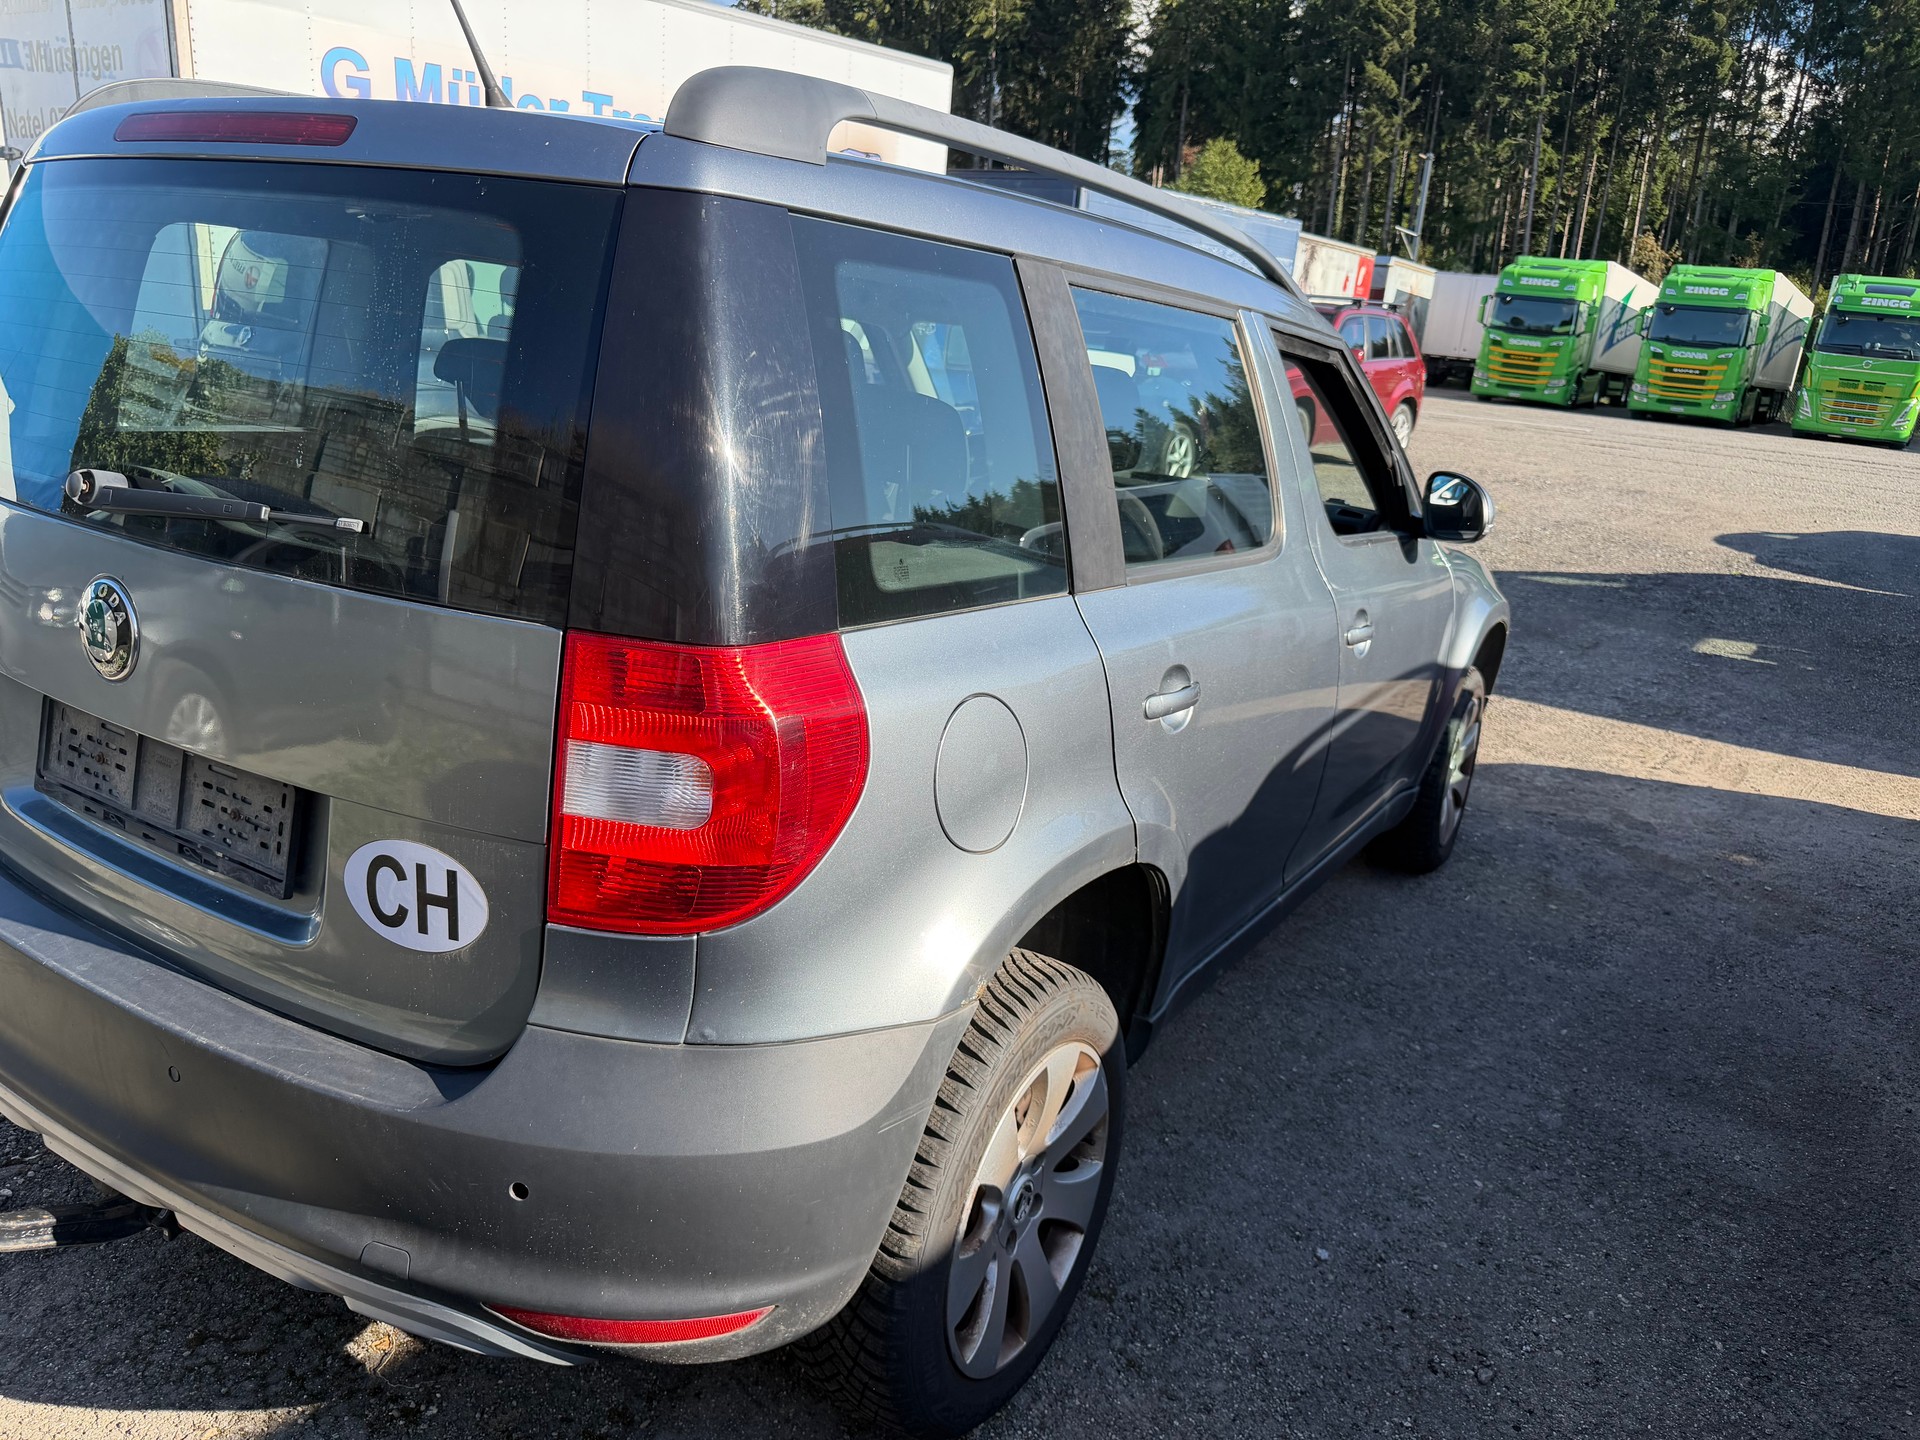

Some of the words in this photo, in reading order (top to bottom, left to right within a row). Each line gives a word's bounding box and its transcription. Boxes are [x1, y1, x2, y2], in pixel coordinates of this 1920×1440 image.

[320, 46, 371, 98] G
[1520, 276, 1560, 288] ZINGG
[1684, 285, 1729, 296] ZINGG
[1861, 297, 1911, 309] ZINGG
[1671, 350, 1708, 360] SCANIA
[366, 854, 459, 941] CH
